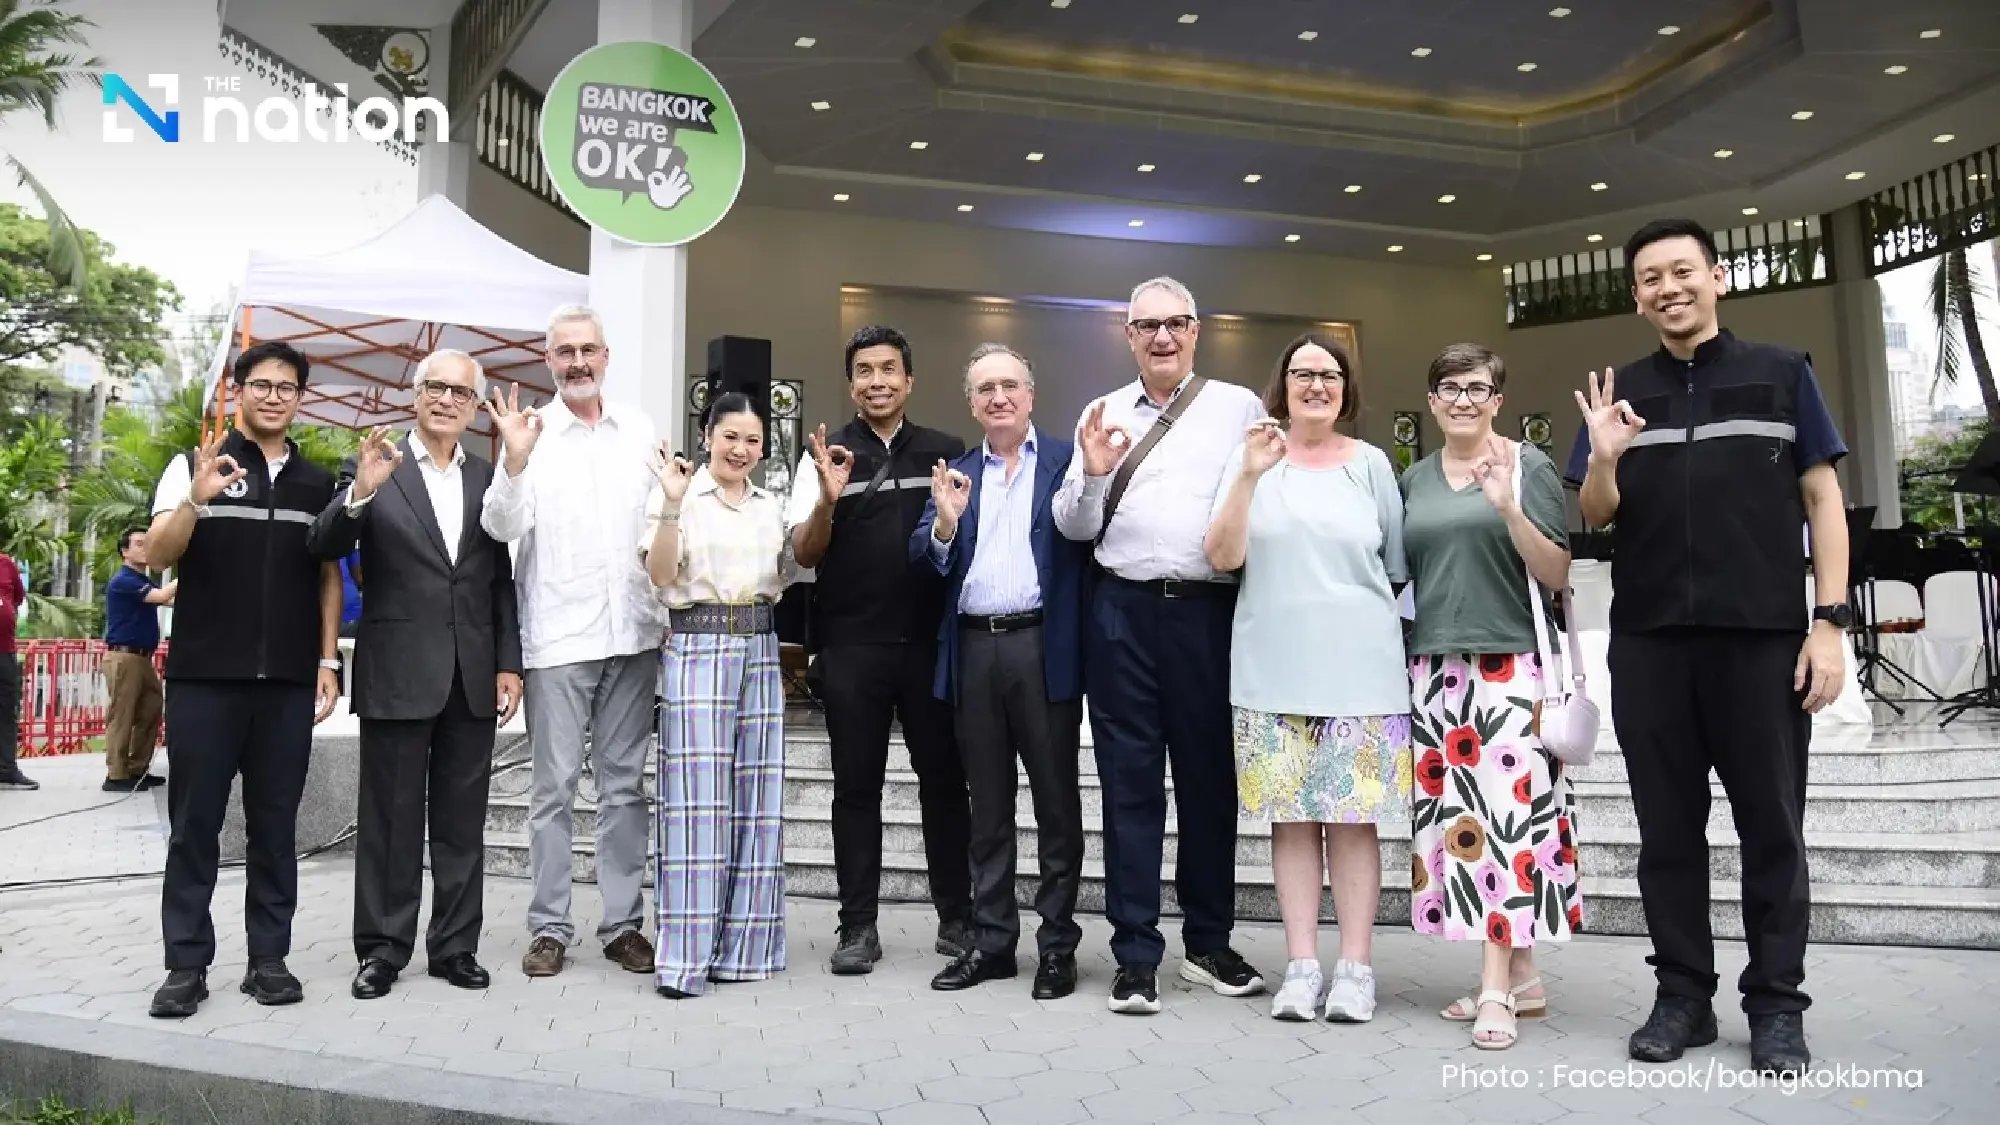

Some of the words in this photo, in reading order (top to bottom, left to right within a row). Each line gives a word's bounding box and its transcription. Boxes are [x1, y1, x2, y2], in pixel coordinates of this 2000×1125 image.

[581, 86, 709, 123] BANGKOK
[579, 114, 619, 136] we
[624, 119, 669, 143] are
